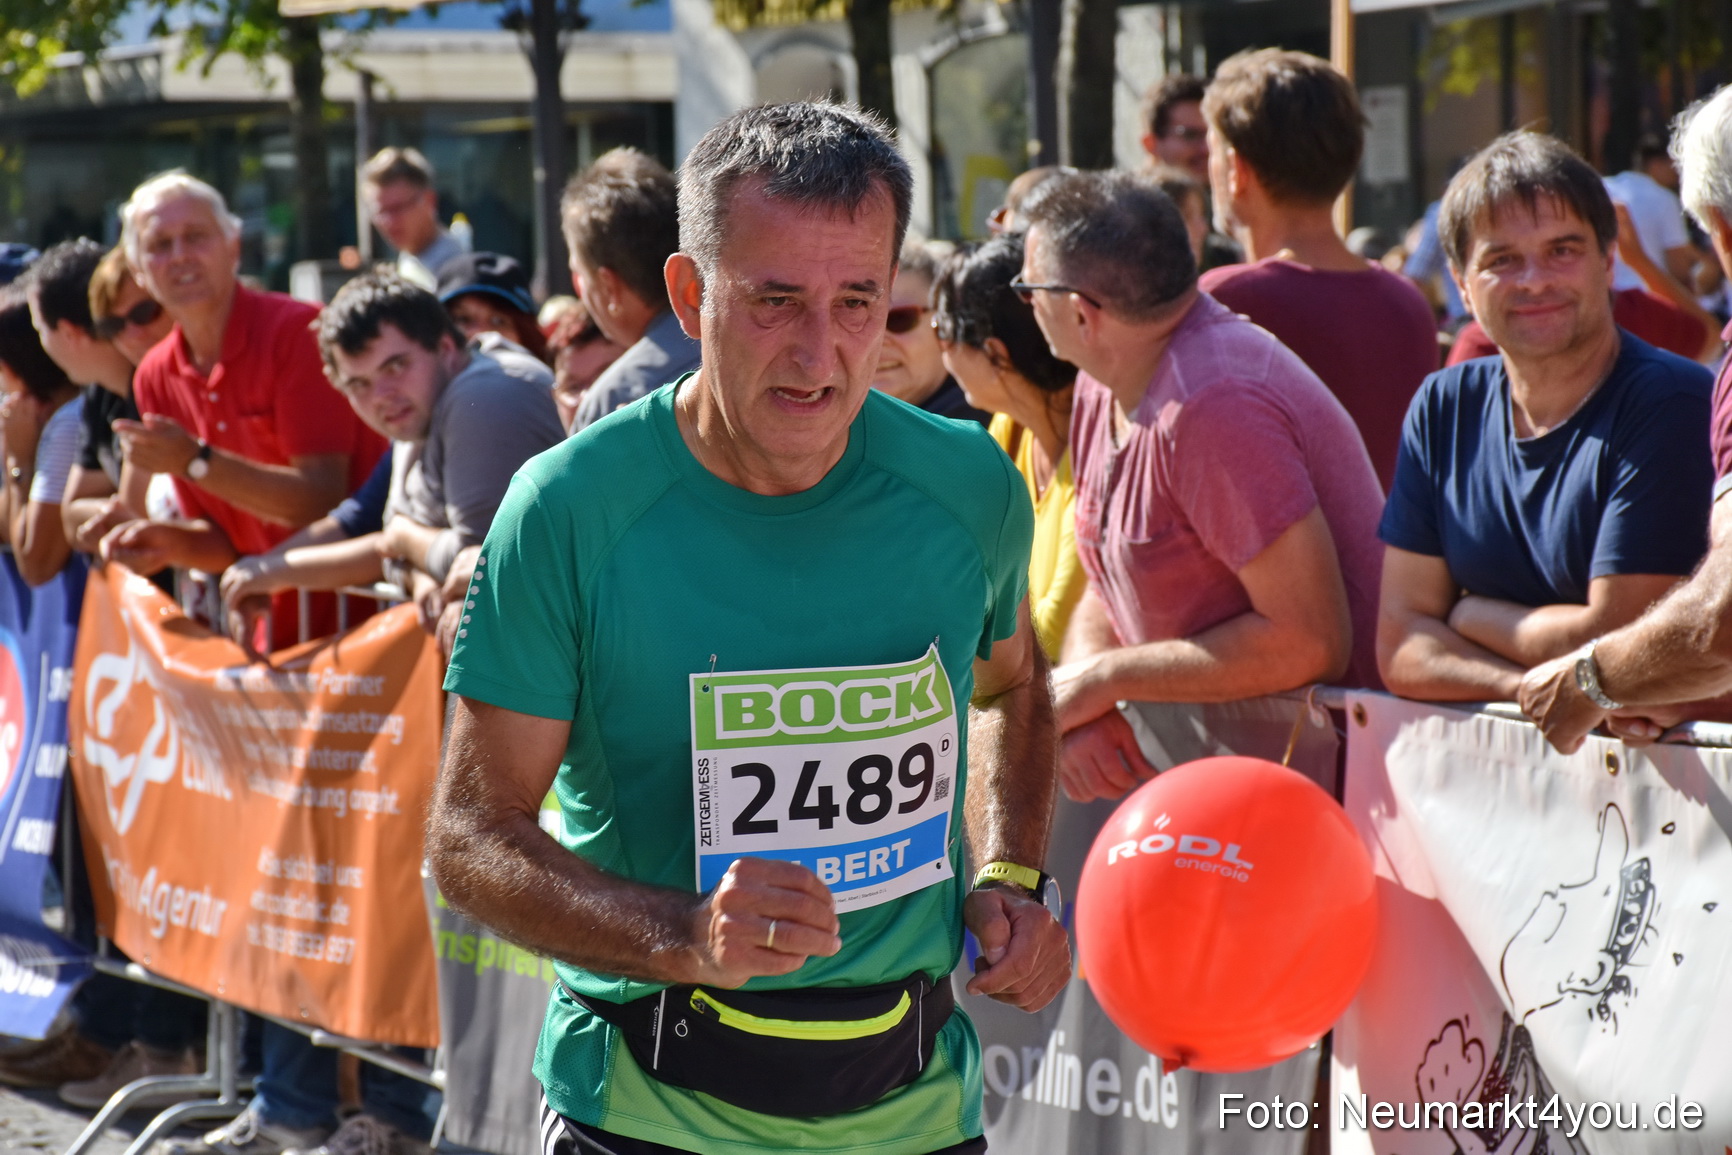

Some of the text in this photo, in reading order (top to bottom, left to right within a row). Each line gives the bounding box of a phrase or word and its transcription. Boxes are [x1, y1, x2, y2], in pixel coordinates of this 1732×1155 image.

[715, 664, 943, 739] BOCK
[941, 738, 950, 752] D
[731, 742, 934, 836] 2489
[1108, 812, 1254, 870] RÖDL
[1174, 857, 1250, 883] energie
[984, 1030, 1179, 1129] online.de
